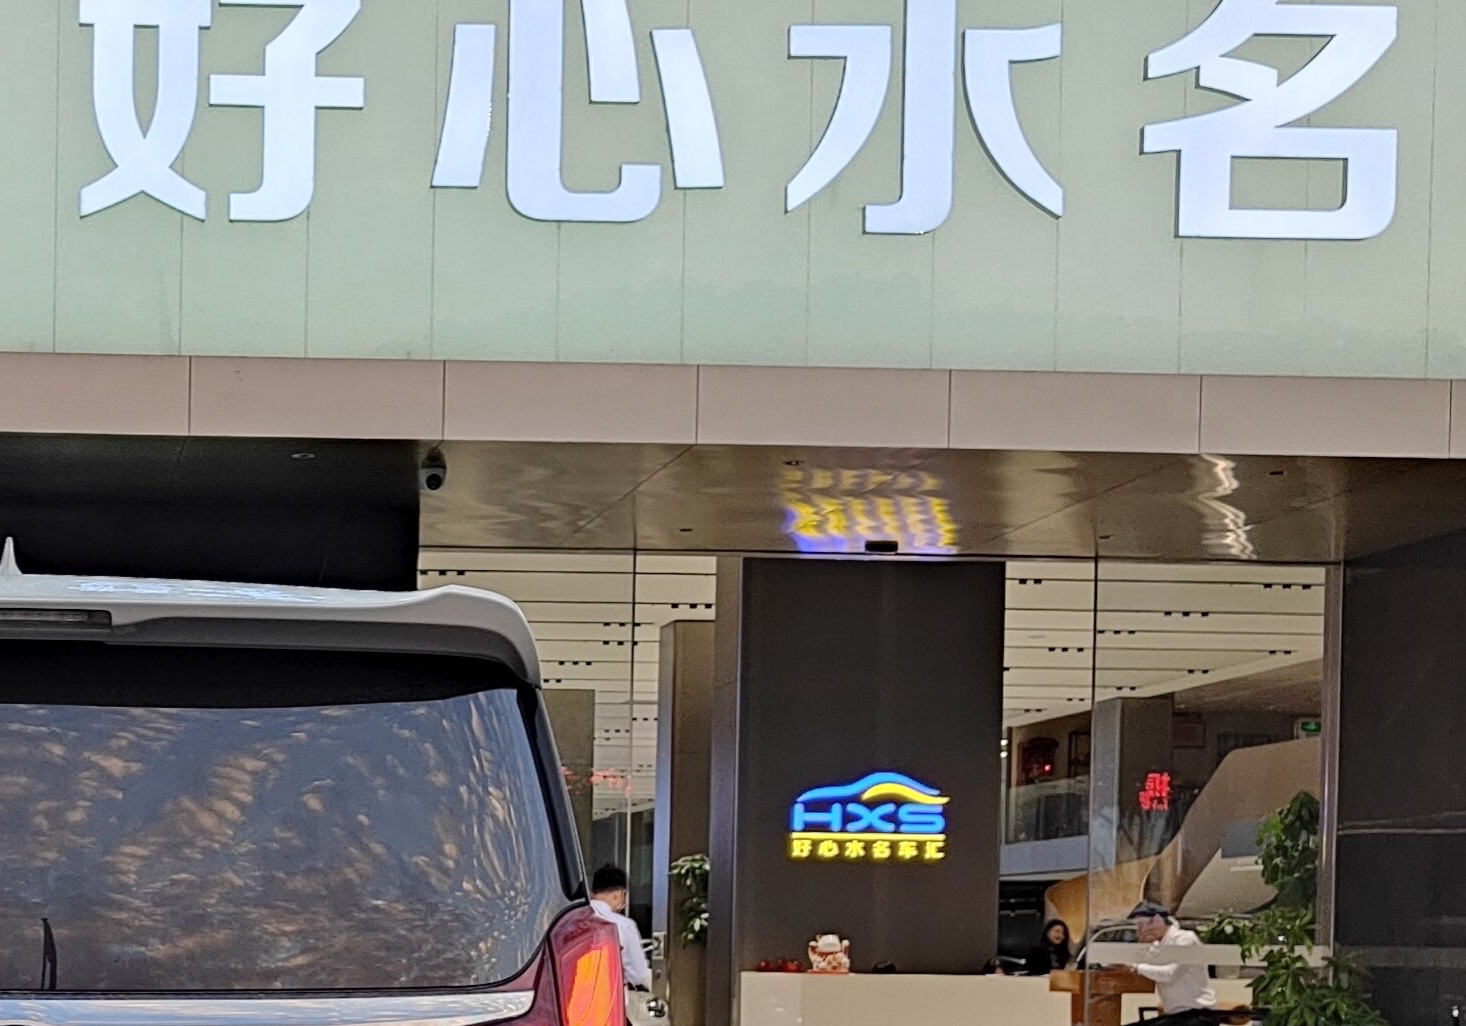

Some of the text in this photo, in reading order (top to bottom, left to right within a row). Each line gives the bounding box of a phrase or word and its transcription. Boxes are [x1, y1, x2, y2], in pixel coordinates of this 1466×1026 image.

[79, 0, 1398, 240] 好心水名
[792, 802, 946, 833] HXS
[791, 839, 945, 860] 好心水名车汇
